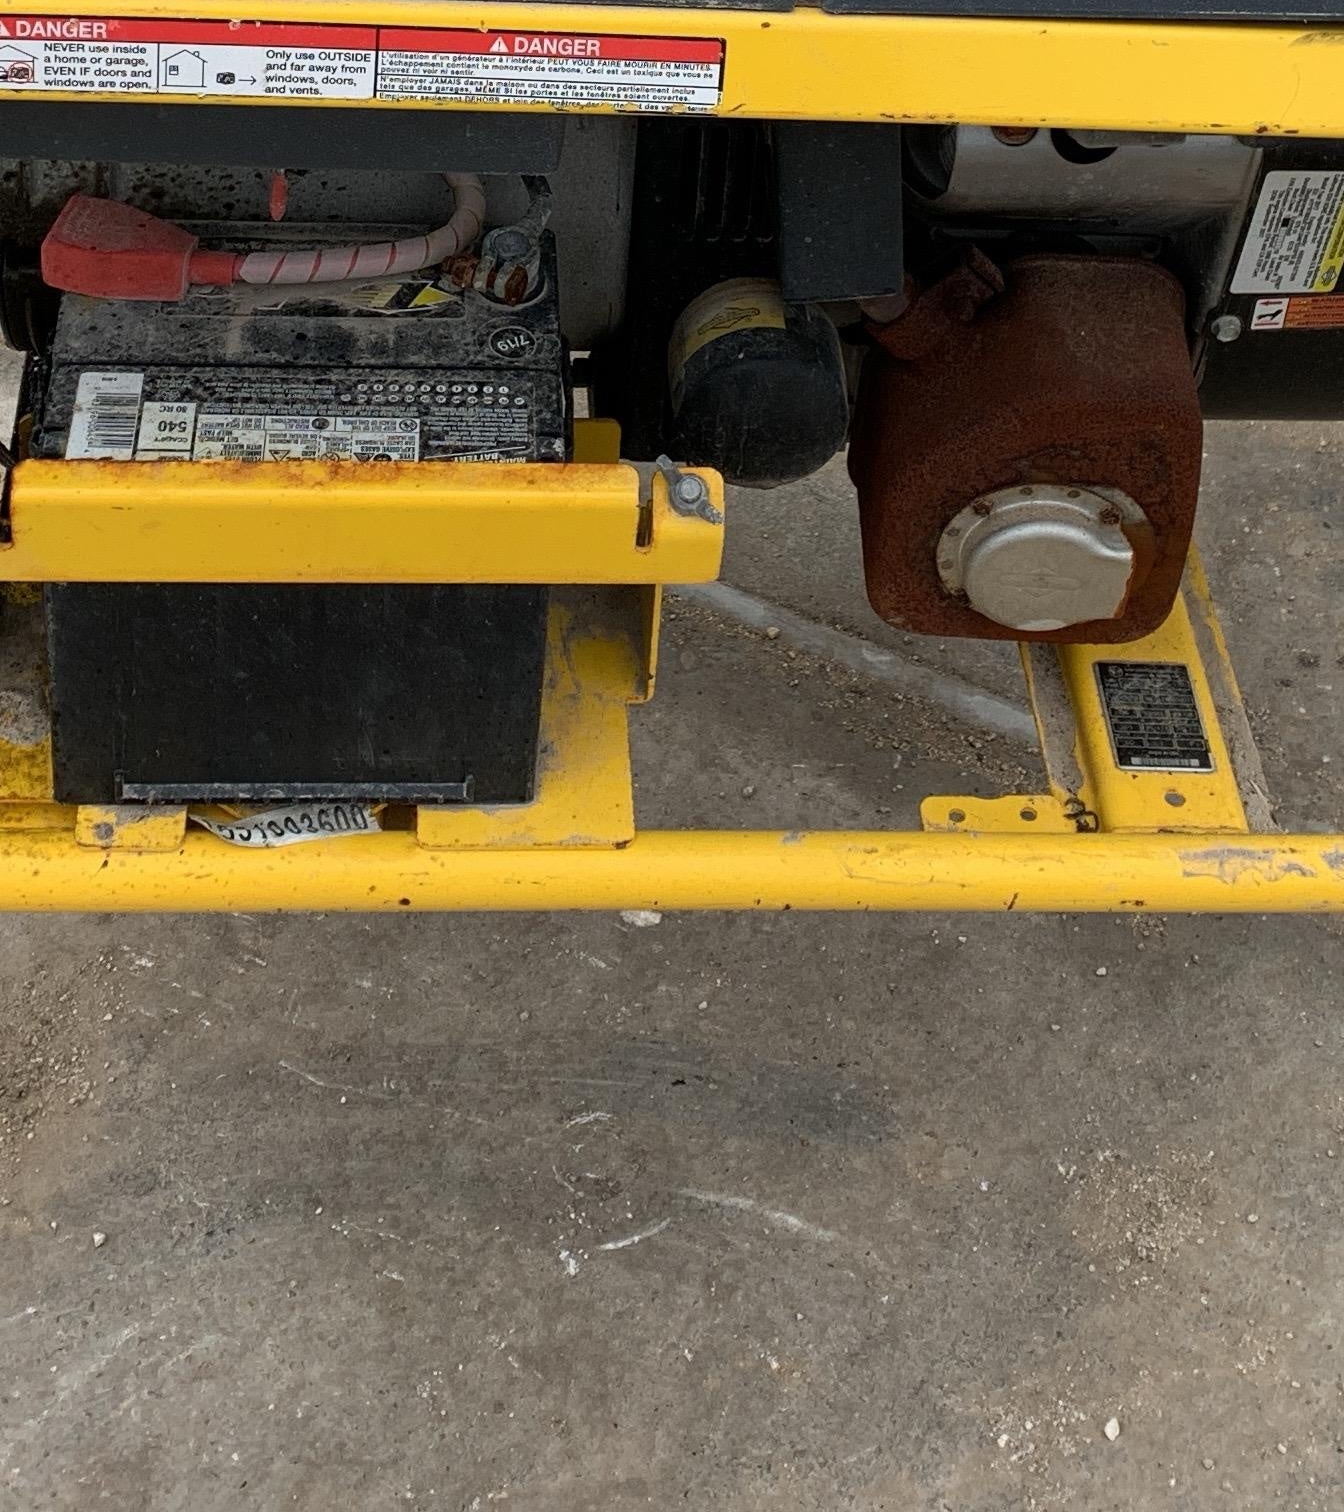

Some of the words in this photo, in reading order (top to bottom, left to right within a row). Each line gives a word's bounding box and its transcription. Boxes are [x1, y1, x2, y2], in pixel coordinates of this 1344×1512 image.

[16, 20, 108, 38] DANGER
[43, 42, 85, 53] NEVER
[88, 45, 109, 53] use
[112, 45, 147, 54] inside
[514, 37, 600, 56] DANGER
[43, 55, 50, 63] a
[54, 54, 87, 64] home
[90, 56, 102, 64] or
[105, 57, 148, 67] garage,
[266, 50, 292, 61] Only
[296, 52, 315, 61] use
[318, 51, 371, 62] OUTSIDE
[43, 66, 76, 76] EVEN
[80, 67, 91, 76] IF
[94, 67, 127, 77] doors
[130, 69, 152, 78] and
[265, 62, 287, 71] and
[290, 62, 306, 72] far
[308, 65, 337, 75] away
[340, 64, 366, 74] from
[43, 78, 95, 87] windows
[98, 80, 116, 88] are
[119, 81, 151, 90] open.
[265, 74, 318, 85] windows,
[321, 76, 356, 86] doors,
[264, 85, 286, 94] and
[289, 87, 322, 95] vents.
[497, 335, 531, 354] 7/19
[158, 420, 188, 432] 540
